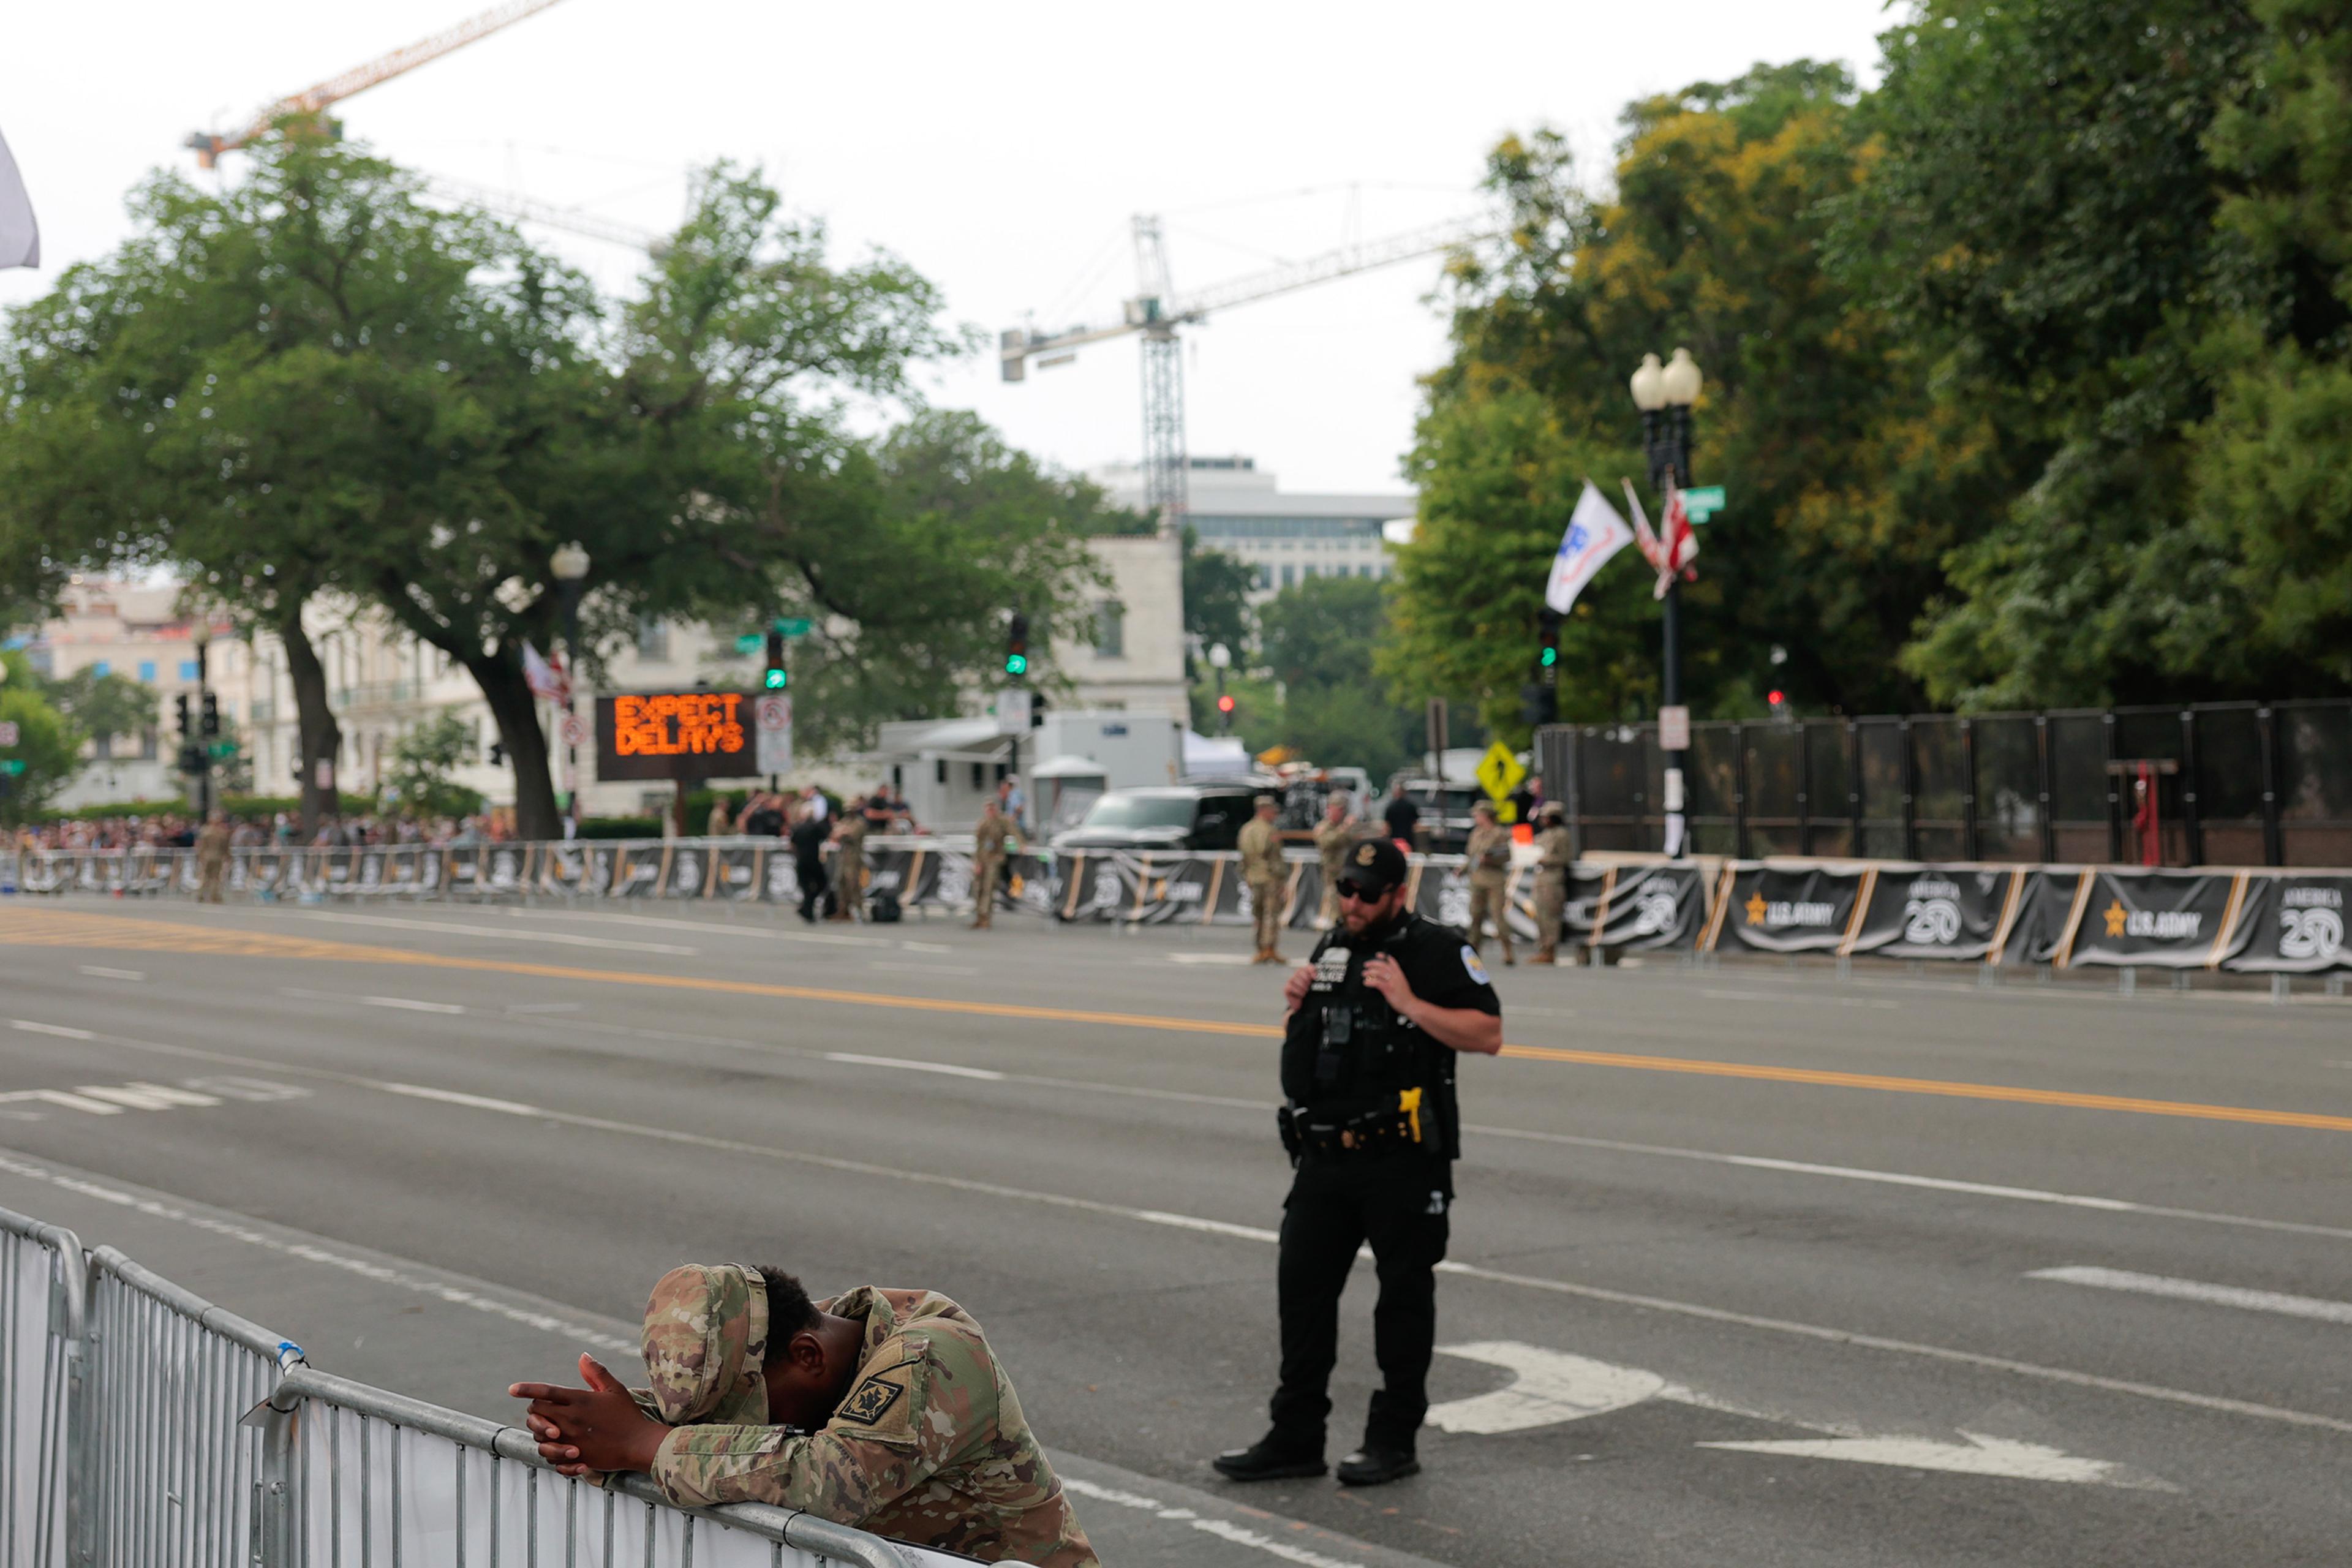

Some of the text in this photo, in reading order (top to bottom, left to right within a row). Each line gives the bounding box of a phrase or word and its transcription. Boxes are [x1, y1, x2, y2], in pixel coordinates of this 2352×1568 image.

[615, 693, 742, 728] EXPECT
[616, 722, 744, 755] DELAYS
[1792, 902, 1835, 926] ARMY
[1905, 899, 1962, 945] 250
[2154, 911, 2202, 938] ARMY
[2279, 908, 2344, 959] 250
